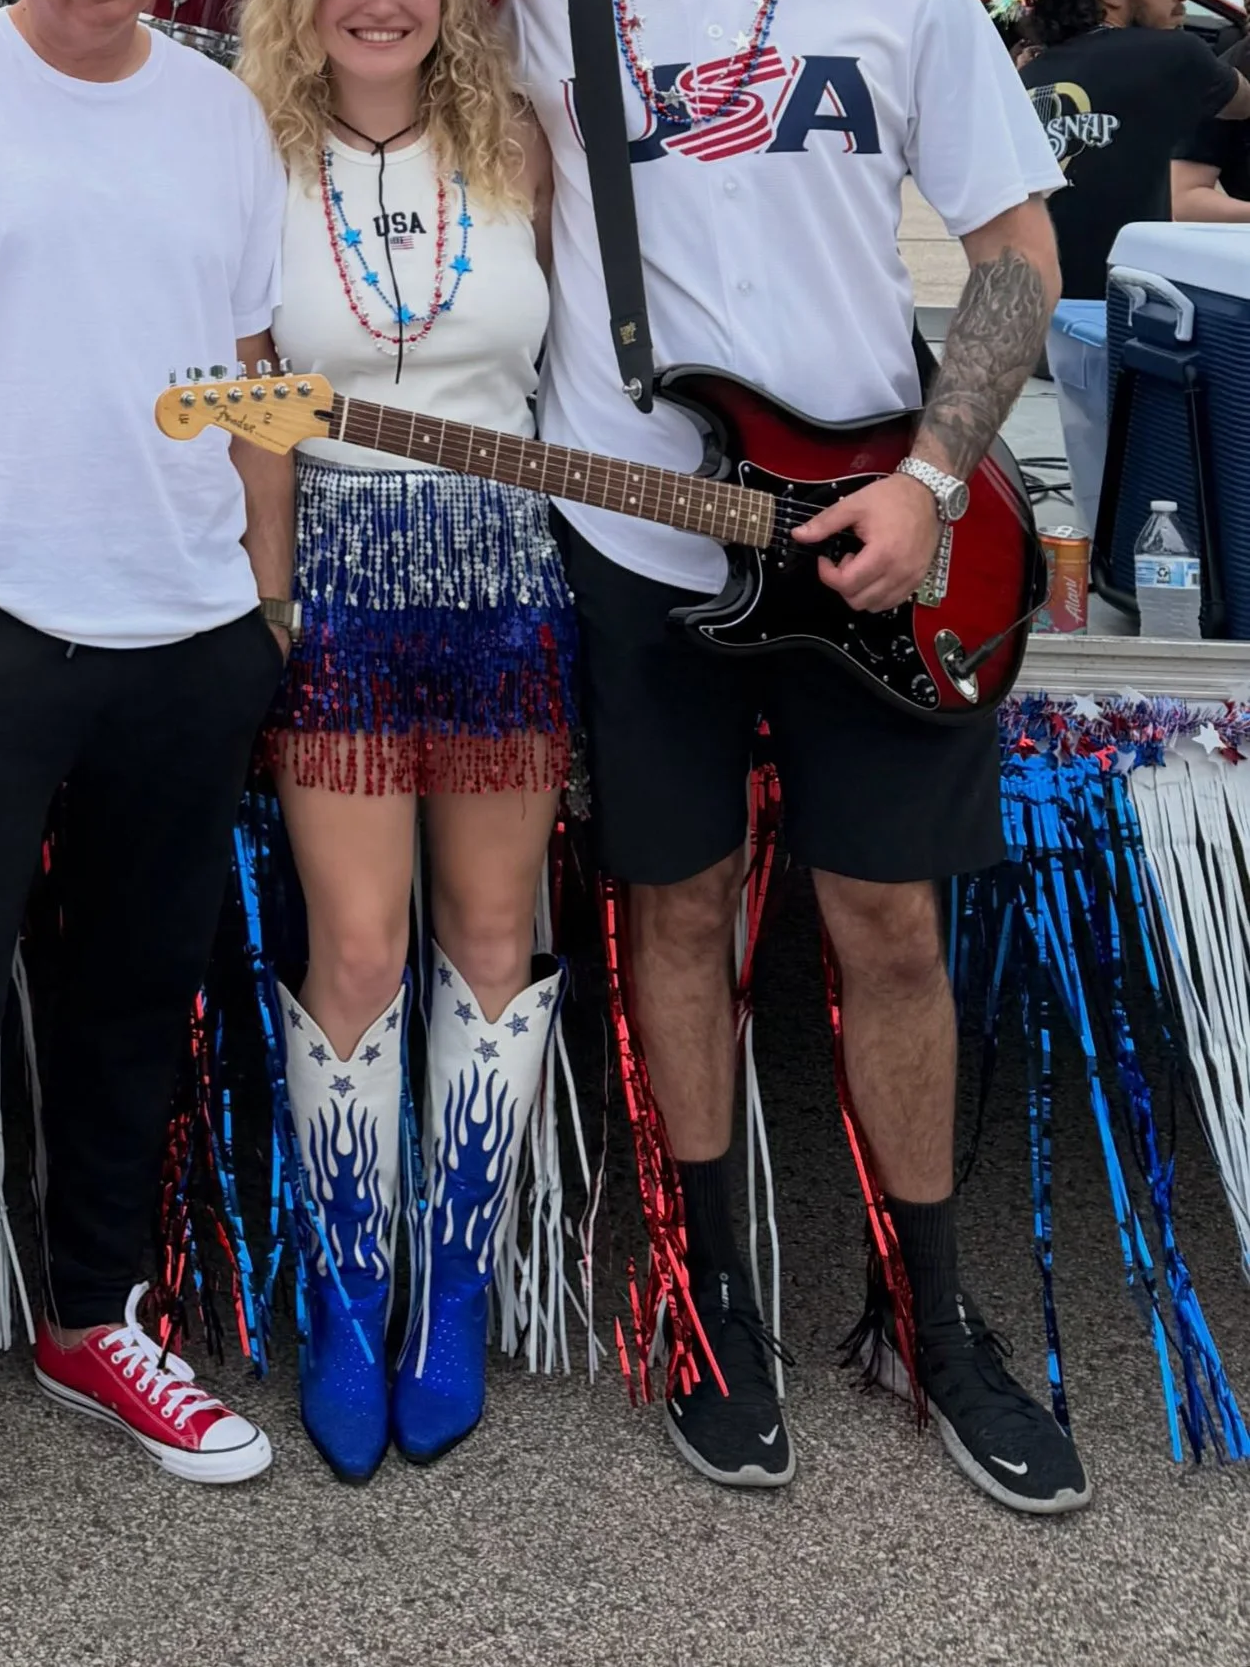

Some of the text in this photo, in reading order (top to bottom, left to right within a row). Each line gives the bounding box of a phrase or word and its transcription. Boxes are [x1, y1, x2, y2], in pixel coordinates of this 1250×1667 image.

[558, 45, 883, 163] USA
[1047, 113, 1119, 162] SNAP
[373, 211, 427, 237] USA
[213, 404, 257, 435] Fender
